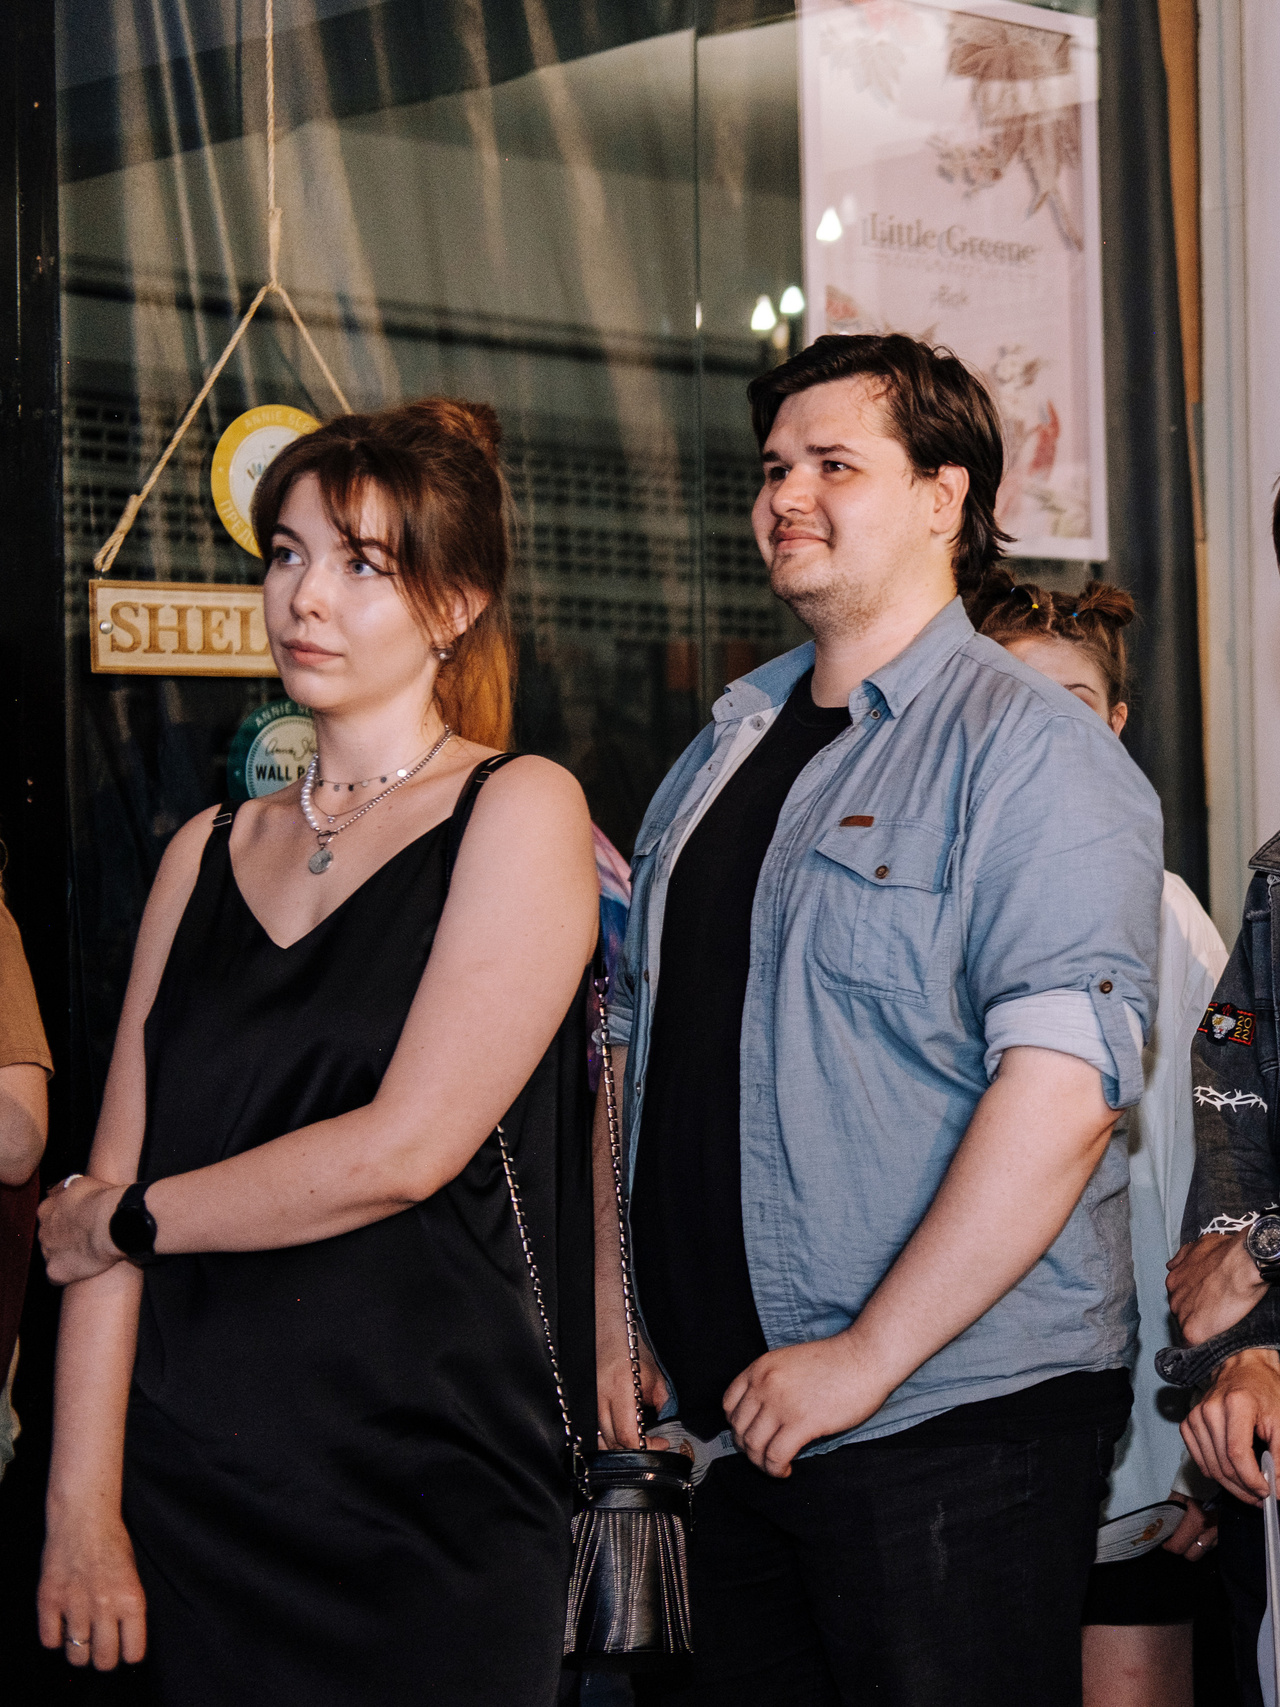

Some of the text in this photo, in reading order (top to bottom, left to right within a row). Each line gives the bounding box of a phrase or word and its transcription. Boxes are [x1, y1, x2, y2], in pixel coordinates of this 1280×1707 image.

[869, 212, 938, 250] Little
[944, 223, 1037, 265] Greene
[255, 701, 292, 729] ANNIE
[255, 764, 293, 781] WALL
[1237, 1015, 1253, 1029] 20
[1233, 1026, 1250, 1041] 22
